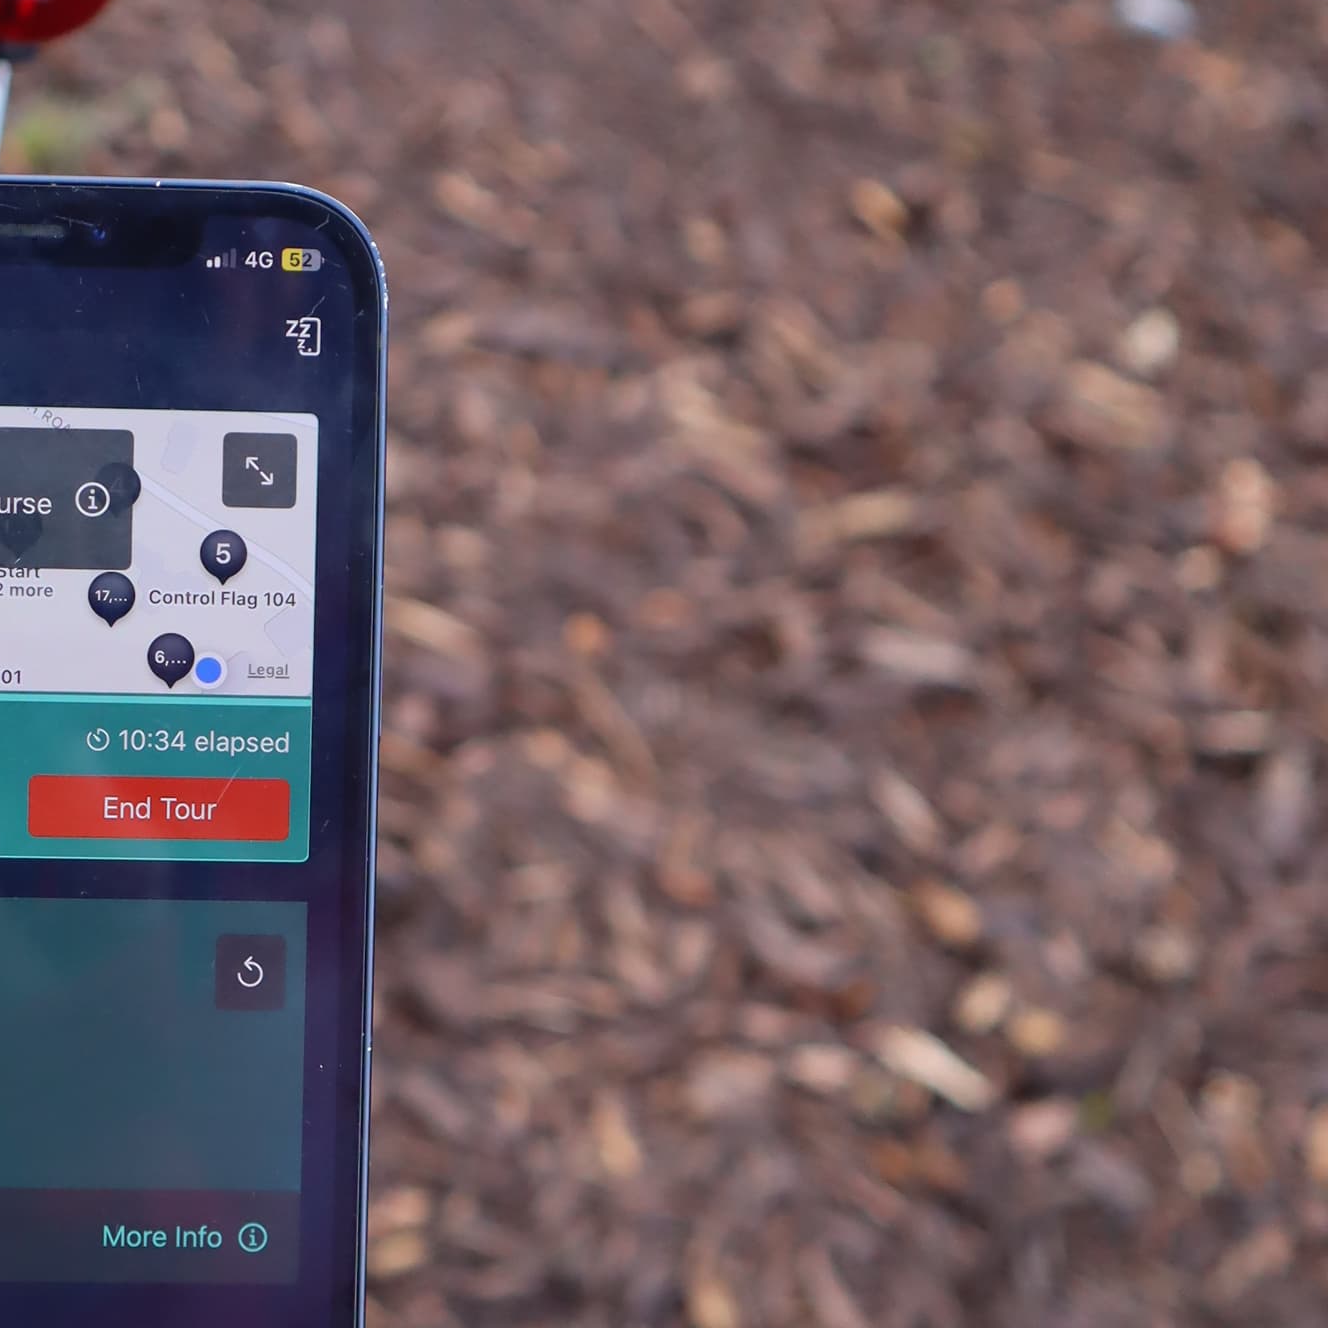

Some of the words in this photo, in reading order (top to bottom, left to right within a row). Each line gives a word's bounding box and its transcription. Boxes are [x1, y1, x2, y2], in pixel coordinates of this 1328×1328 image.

[244, 251, 274, 268] 4G
[289, 252, 313, 267] 52
[215, 543, 232, 564] 5
[9, 586, 54, 597] more
[149, 589, 215, 605] Control
[221, 591, 258, 609] Flag
[264, 592, 296, 607] 104
[248, 663, 289, 678] Legal
[118, 729, 187, 752] 10:34
[194, 730, 290, 756] elapsed
[103, 796, 151, 820] End
[160, 797, 217, 821] Tour
[102, 1225, 167, 1248] More
[175, 1225, 223, 1248] Info
